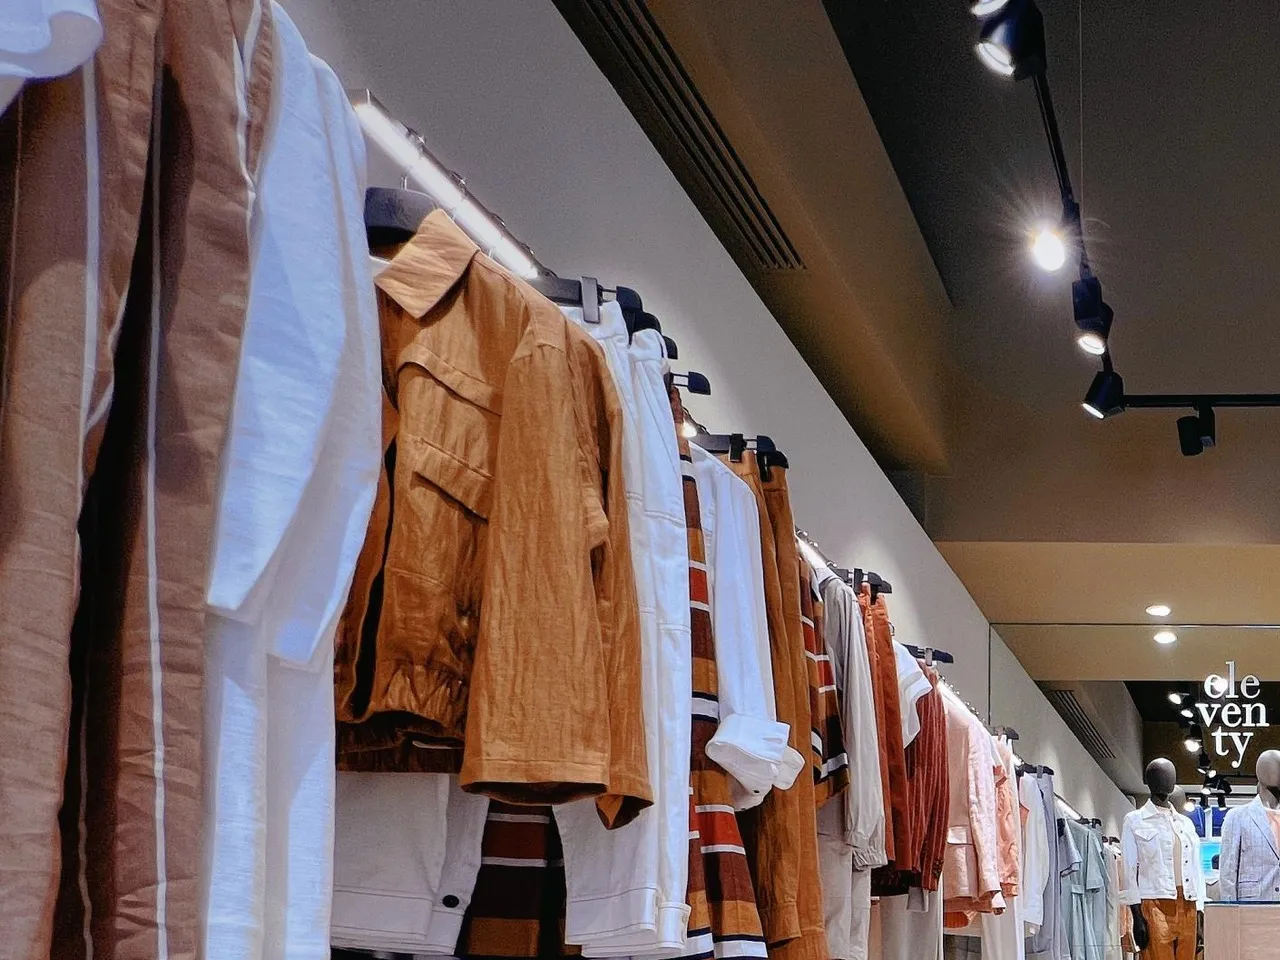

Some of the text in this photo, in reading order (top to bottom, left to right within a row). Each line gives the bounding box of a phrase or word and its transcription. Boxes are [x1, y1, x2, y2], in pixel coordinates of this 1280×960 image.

[1203, 661, 1260, 699] ele
[1195, 702, 1270, 728] ven
[1211, 726, 1254, 768] ty
